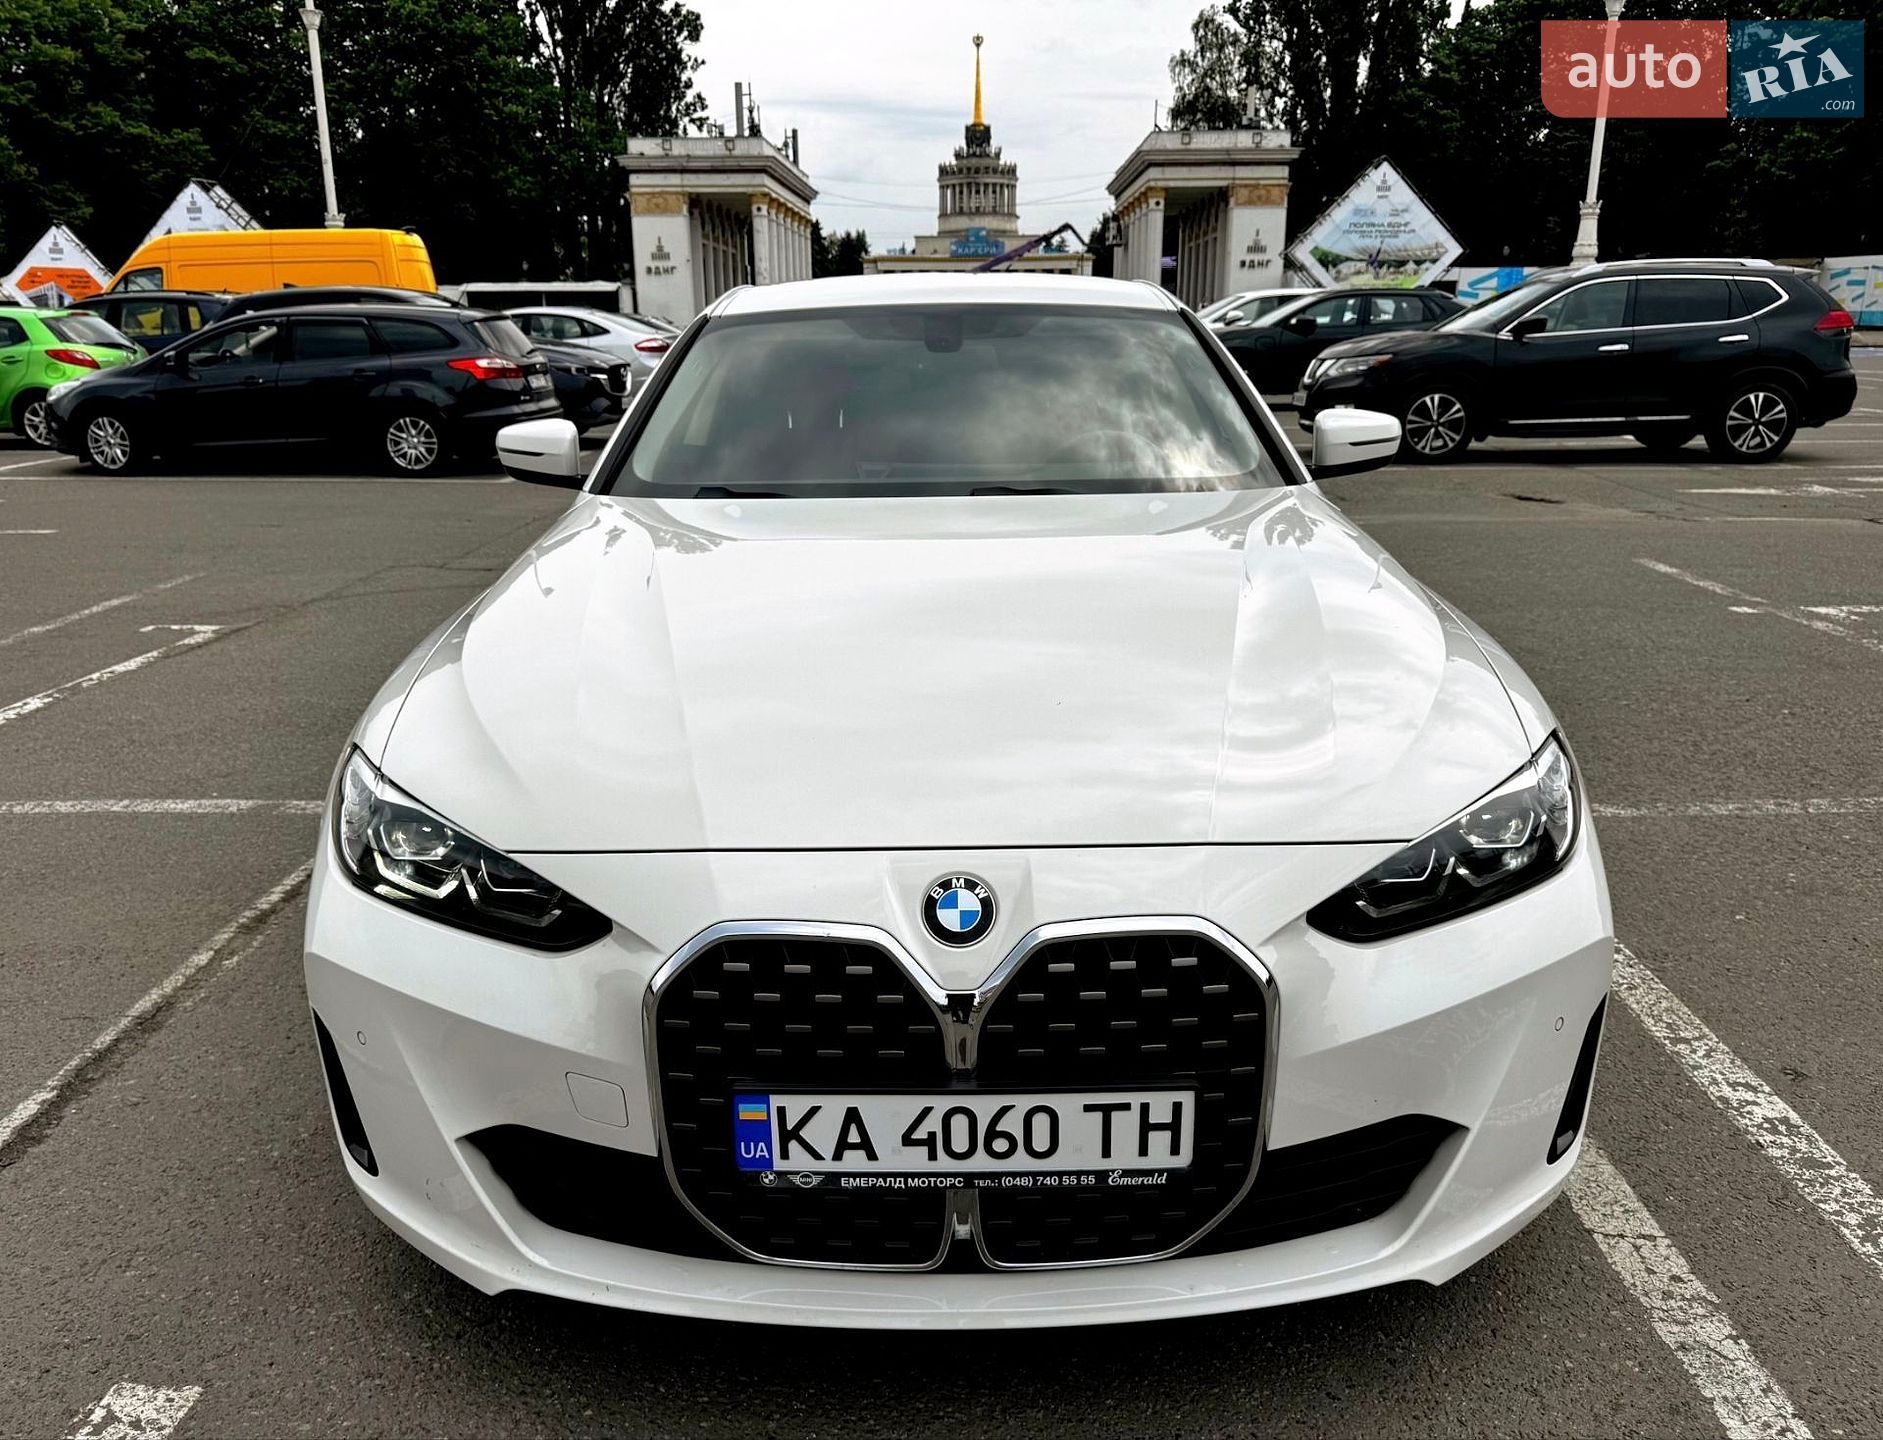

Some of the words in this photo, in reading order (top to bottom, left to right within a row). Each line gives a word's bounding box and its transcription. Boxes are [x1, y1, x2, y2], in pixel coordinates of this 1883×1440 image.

[930, 877, 989, 900] BMW
[776, 1105, 879, 1161] KA
[901, 1104, 1059, 1161] 4060
[1083, 1101, 1183, 1159] TH
[740, 1141, 770, 1159] UA
[841, 1177, 905, 1189] ЕМЕРАЛД
[907, 1177, 964, 1187] МОТОРС
[1001, 1176, 1033, 1188] (048)
[1036, 1176, 1059, 1186] 740
[1062, 1175, 1077, 1185] 55
[1080, 1175, 1096, 1185] 55
[1108, 1169, 1167, 1186] Emerald
